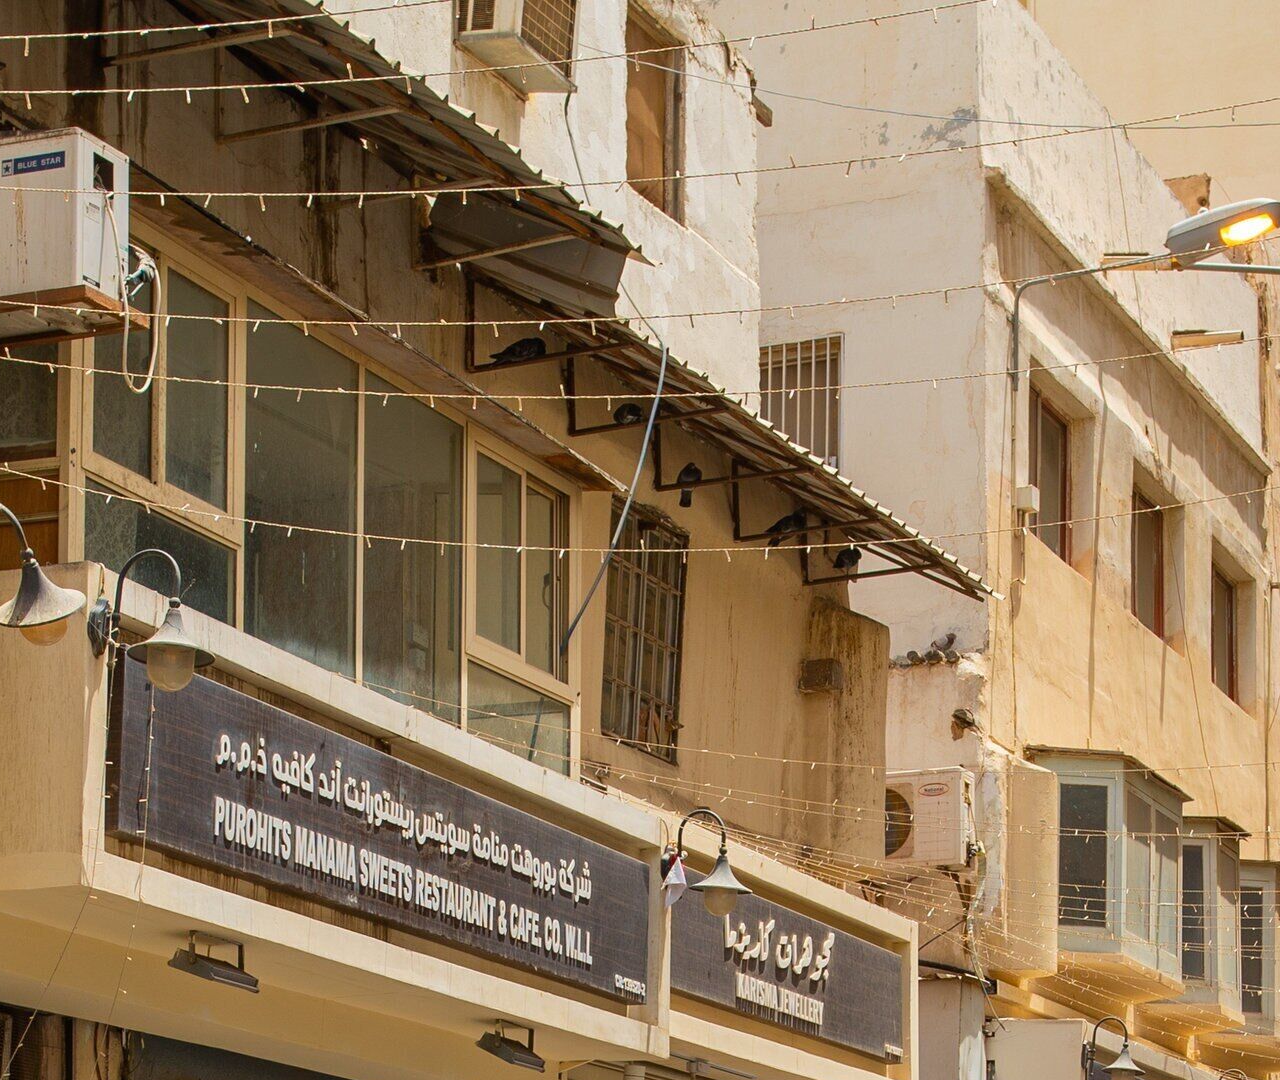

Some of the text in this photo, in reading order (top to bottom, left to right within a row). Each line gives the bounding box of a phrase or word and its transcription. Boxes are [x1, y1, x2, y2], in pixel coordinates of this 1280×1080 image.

[17, 156, 61, 170] BLUE STAR
[272, 751, 315, 794] كافيه
[319, 760, 342, 802] أند
[344, 777, 414, 839] ريستورانت
[416, 812, 470, 854] سويتس
[473, 824, 508, 867] منامة
[215, 797, 593, 965] PUROHITS MANAMA SWEETS RESTAURANT & CAFE. CO. W.L.L
[559, 859, 592, 902] شركة
[736, 972, 824, 1026] KARISMA JEWELLERY
